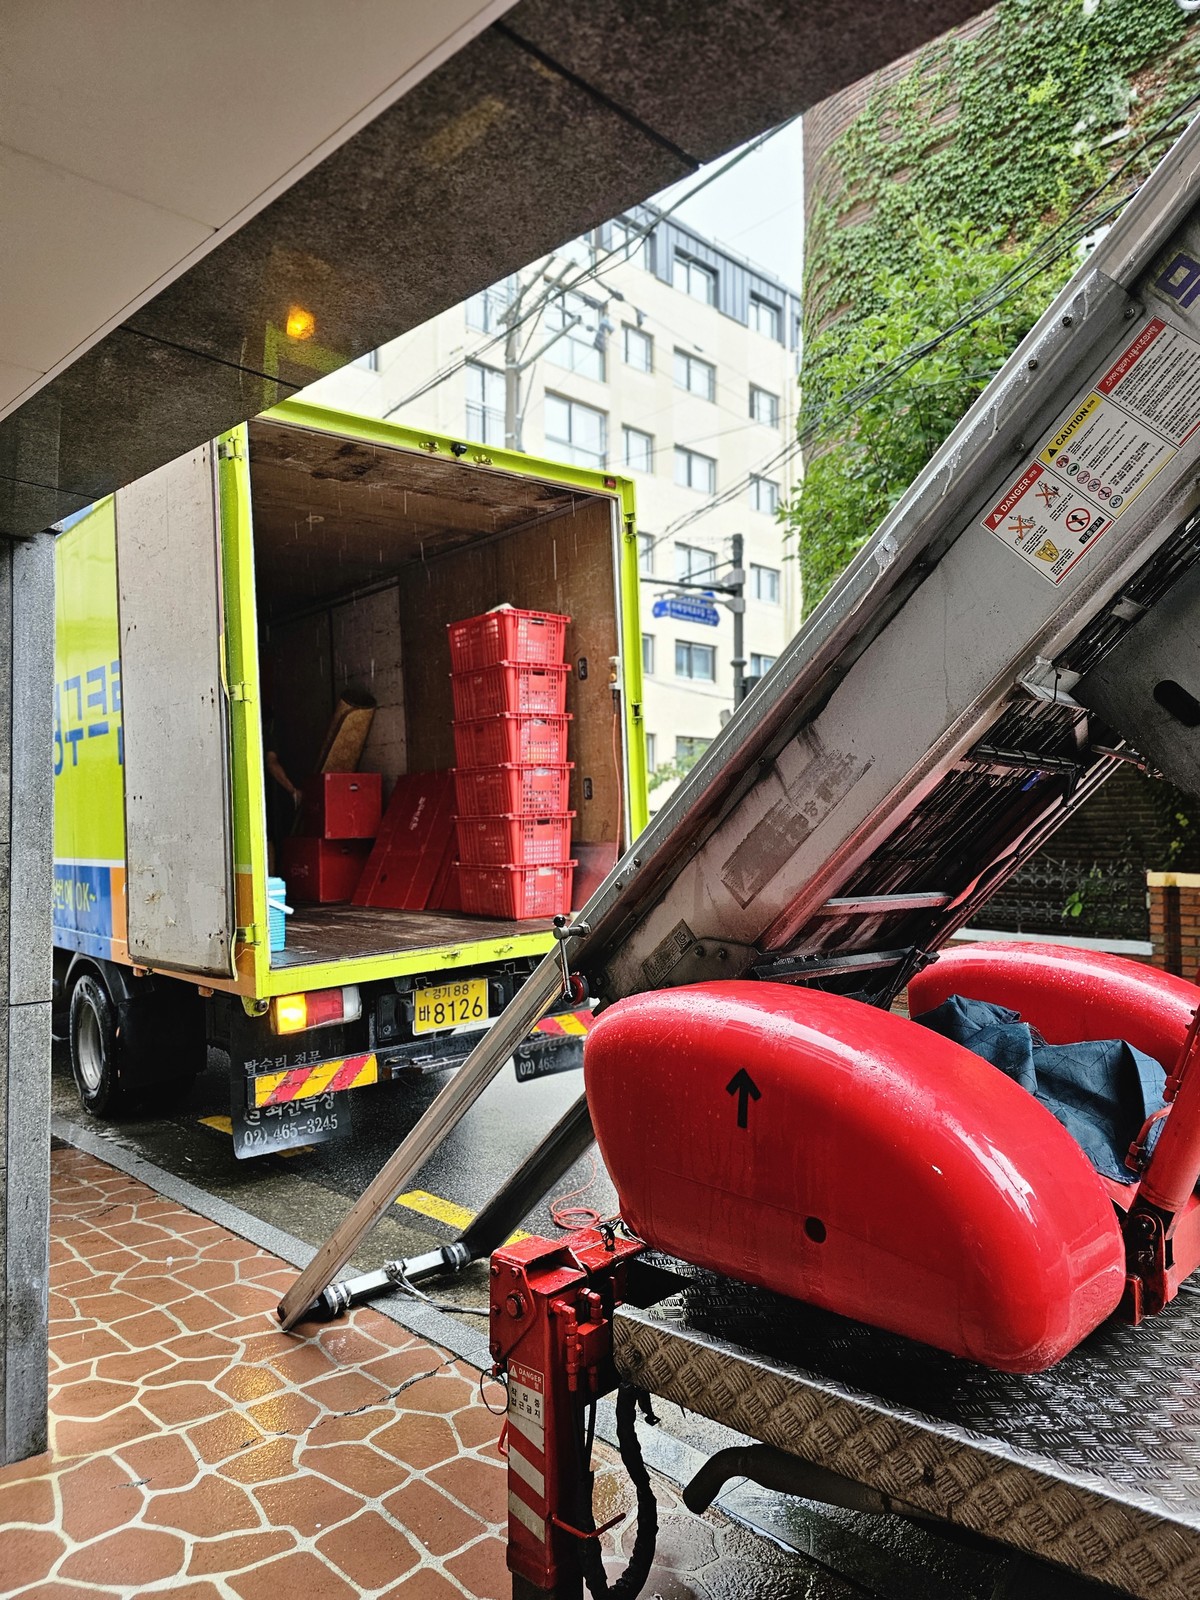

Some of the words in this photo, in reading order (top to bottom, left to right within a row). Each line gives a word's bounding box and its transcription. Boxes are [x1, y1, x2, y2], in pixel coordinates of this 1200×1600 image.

[1104, 370, 1119, 387] 스카이
[1127, 343, 1143, 360] 사용시
[1138, 324, 1158, 347] 주의사항
[1055, 406, 1088, 447] CAUTION
[1000, 477, 1030, 512] DANGER
[1109, 495, 1121, 507] A/S
[433, 987, 451, 999] 경기
[454, 984, 469, 996] 88
[419, 1005, 430, 1022] 바
[434, 996, 483, 1024] 8126
[244, 1055, 287, 1075] 탑수리
[520, 1059, 535, 1075] 02)
[244, 1127, 268, 1147] 02)
[273, 1114, 338, 1142] 465-3245
[518, 1367, 542, 1384] DANGER
